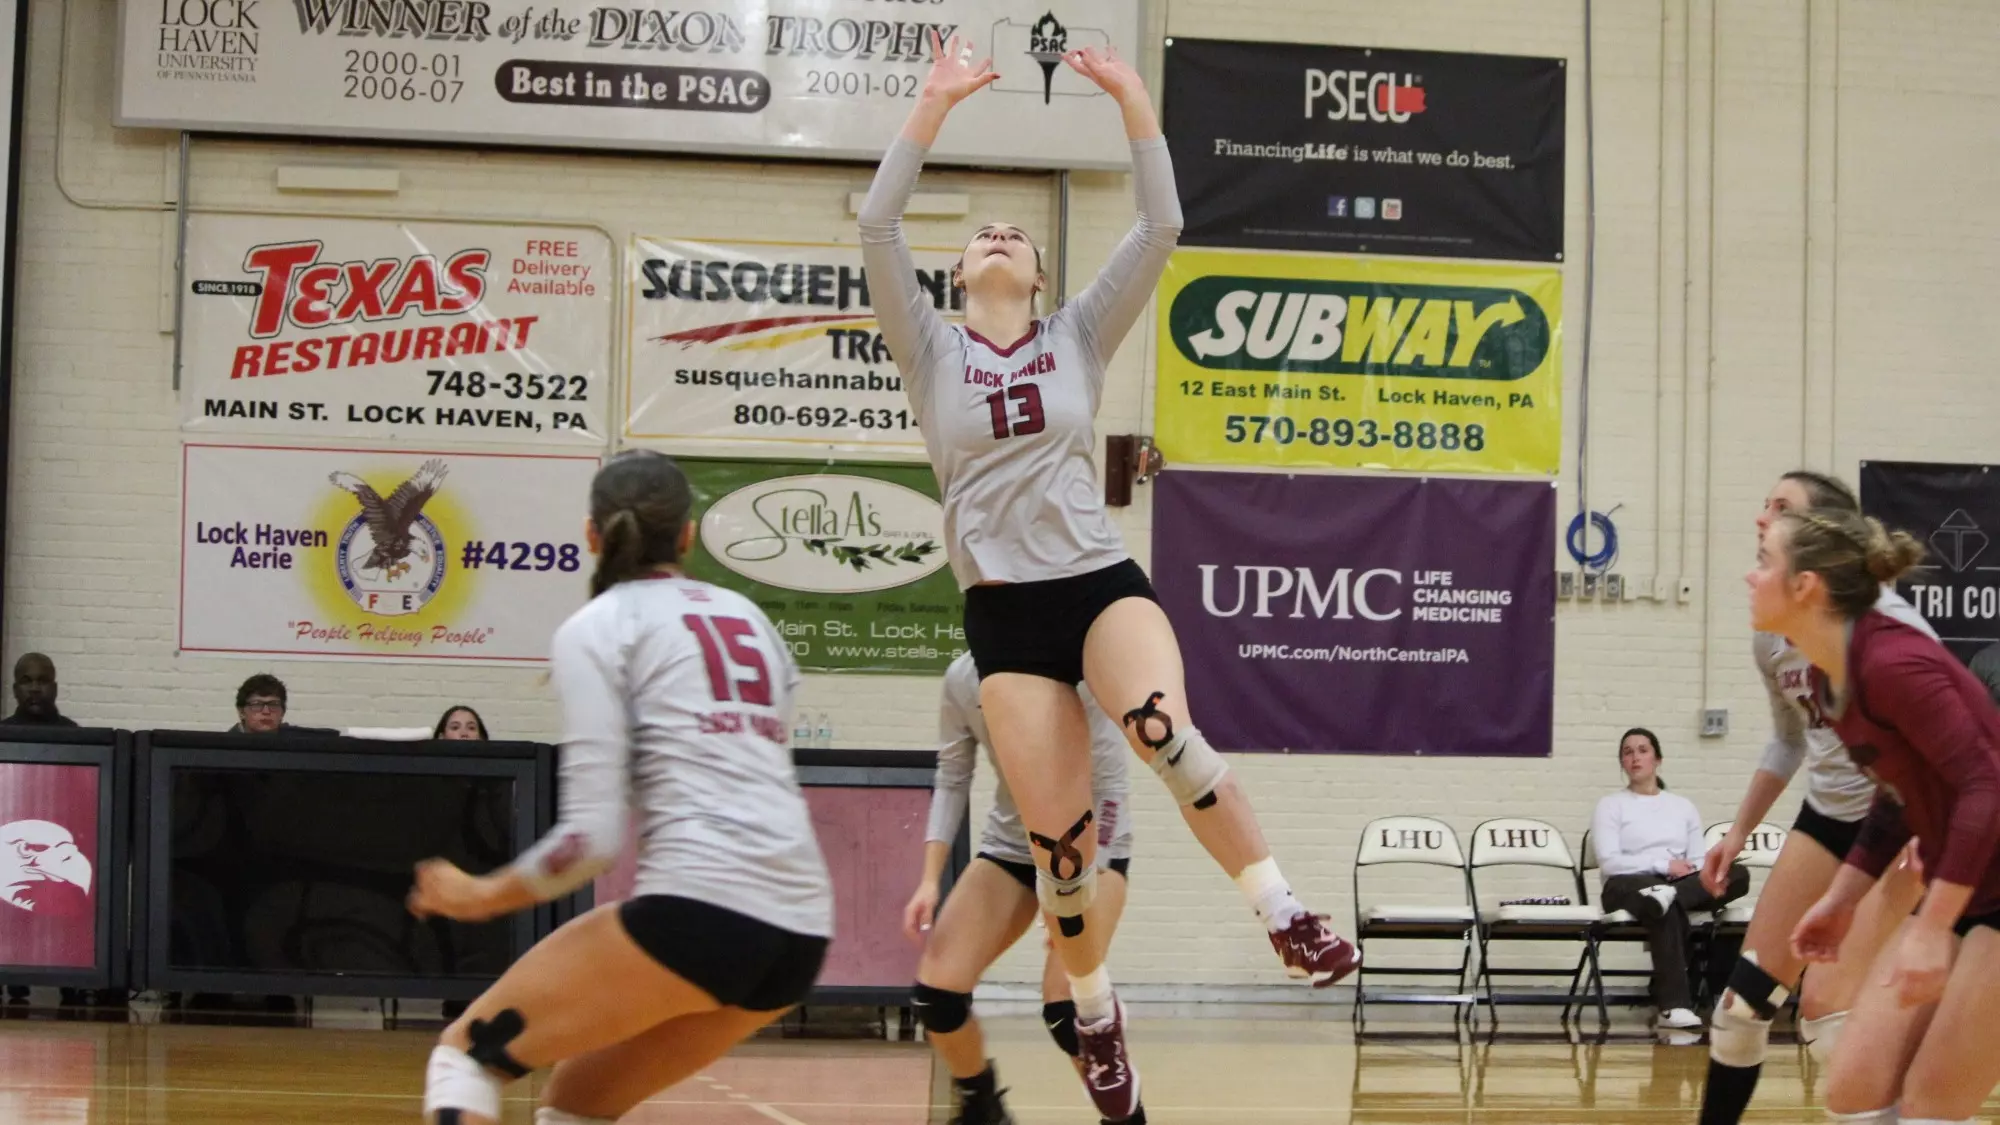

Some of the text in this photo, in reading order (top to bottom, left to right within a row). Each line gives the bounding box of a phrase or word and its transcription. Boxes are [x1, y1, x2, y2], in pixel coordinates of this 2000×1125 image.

[161, 0, 259, 29] LOCK
[159, 28, 259, 55] HAVEN
[296, 0, 958, 59] WINNER of the DIXON TROPHY
[1031, 36, 1067, 53] PSAC
[158, 53, 257, 71] UNIVERSITY
[344, 50, 461, 77] 2000-01
[157, 70, 256, 83] OF PENNSYLVANIA
[344, 75, 464, 103] 2006-07
[512, 66, 760, 106] Best in the PSAC
[806, 70, 918, 98] 2001-02
[1304, 68, 1413, 123] PSECU
[1354, 146, 1368, 162] is
[1372, 148, 1413, 165] what
[1416, 153, 1442, 167] we
[1446, 150, 1470, 168] do
[1473, 153, 1516, 170] best.
[526, 240, 578, 257] FREE
[512, 259, 591, 281] Delivery
[198, 283, 256, 294] SINCE 1918
[243, 240, 491, 339] TEXAS
[507, 278, 596, 297] Available
[642, 258, 963, 312] SUSQUEHN
[1187, 289, 1526, 368] SUBWAY
[230, 316, 539, 380] RESTAURANT
[426, 370, 588, 401] 748-3522
[675, 367, 906, 392] susquehannabu
[964, 364, 1004, 388] LOCK
[1180, 380, 1534, 410] 12 East Main St. Lock Haven, PA
[204, 400, 588, 432] MAIN ST. LOCK HAVEN, PA
[986, 382, 1046, 440] 13
[1225, 415, 1485, 452] 570-893-8888
[197, 521, 328, 548] Lock Haven
[725, 488, 882, 561] Stella A's
[230, 548, 293, 570] Aerie
[461, 540, 581, 573] #4298
[1413, 570, 1453, 586] LIFE
[1198, 563, 1403, 622] UPMC
[1413, 588, 1512, 606] CHANGING
[1910, 584, 2000, 619] TRI CO
[1413, 606, 1502, 623] MEDICINE
[357, 622, 423, 647] Helping
[823, 620, 858, 638] St.
[870, 621, 927, 640] Lock
[682, 613, 775, 707] 15
[1238, 643, 1469, 663] UPMC.com/NorthCentralPA
[1381, 828, 1443, 850] LHU
[1489, 828, 1550, 848] LHU
[1720, 832, 1782, 851] HU
